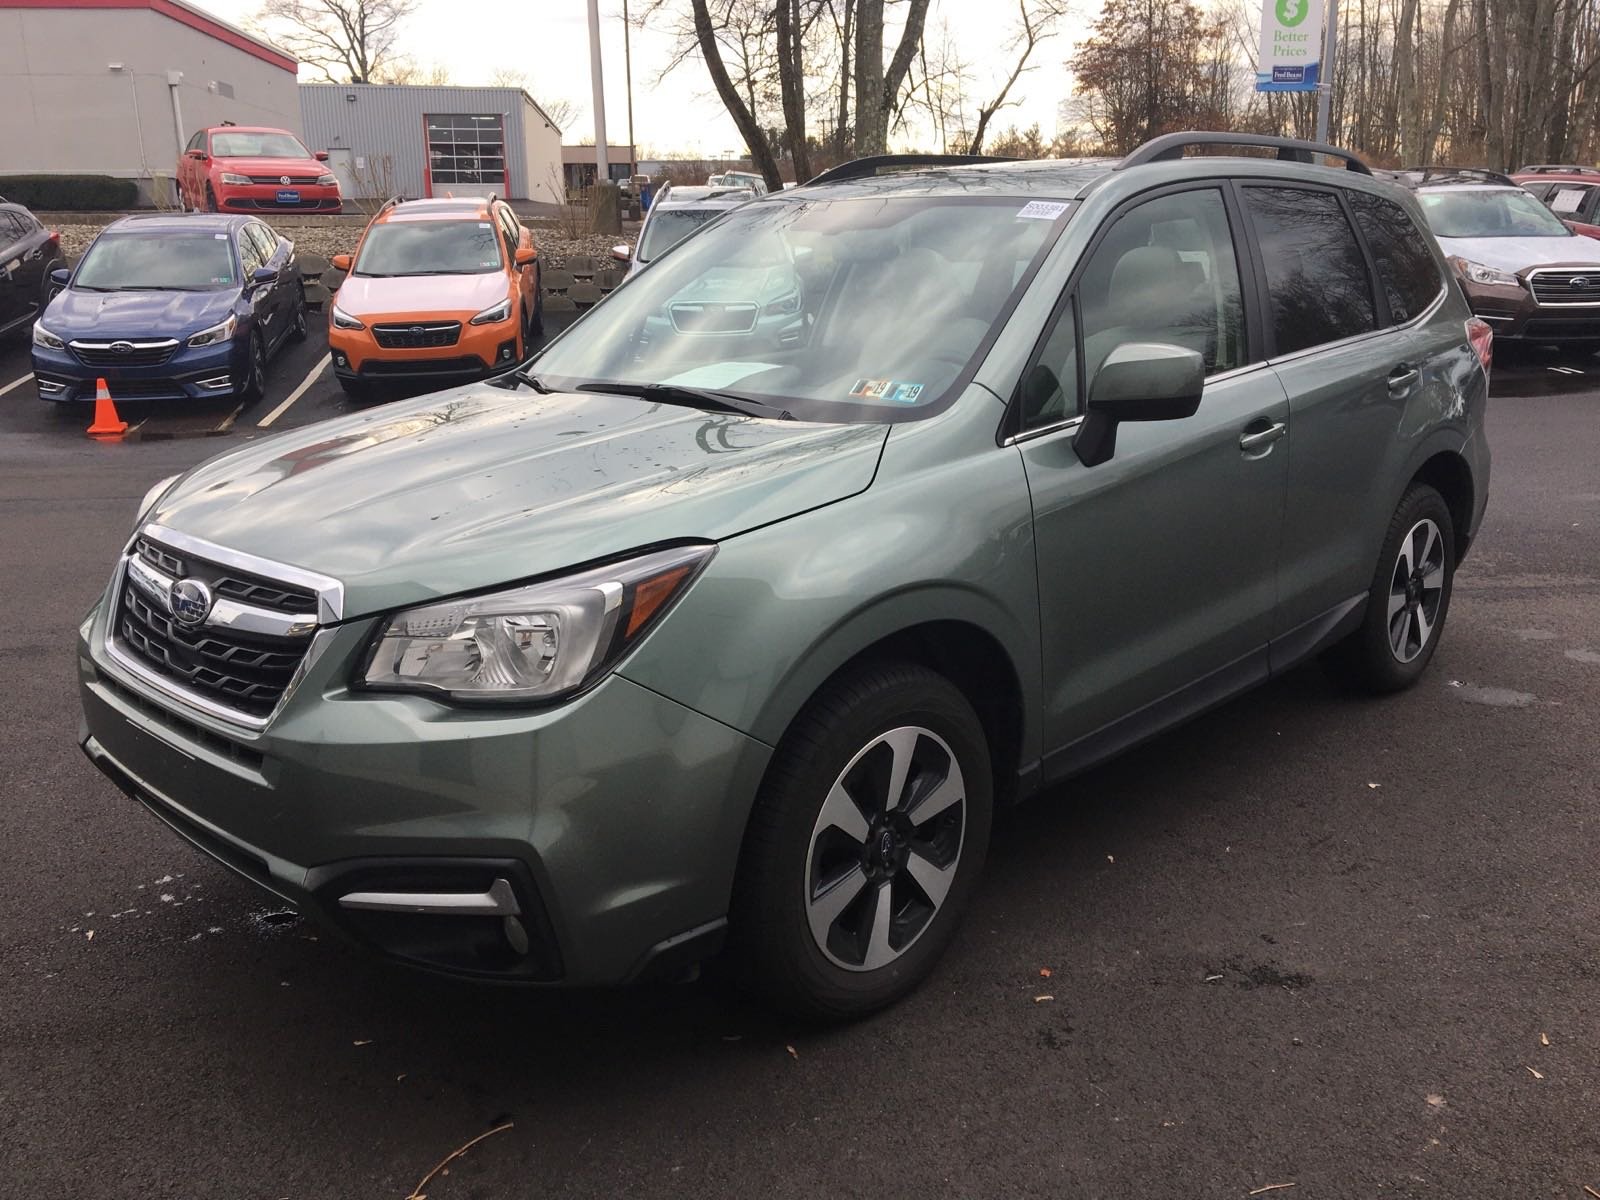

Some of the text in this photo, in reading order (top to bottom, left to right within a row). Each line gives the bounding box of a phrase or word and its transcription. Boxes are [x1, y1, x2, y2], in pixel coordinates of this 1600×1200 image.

[1273, 30, 1309, 41] Better
[1273, 45, 1307, 57] Prices
[873, 382, 887, 394] 19
[905, 386, 920, 399] 19
